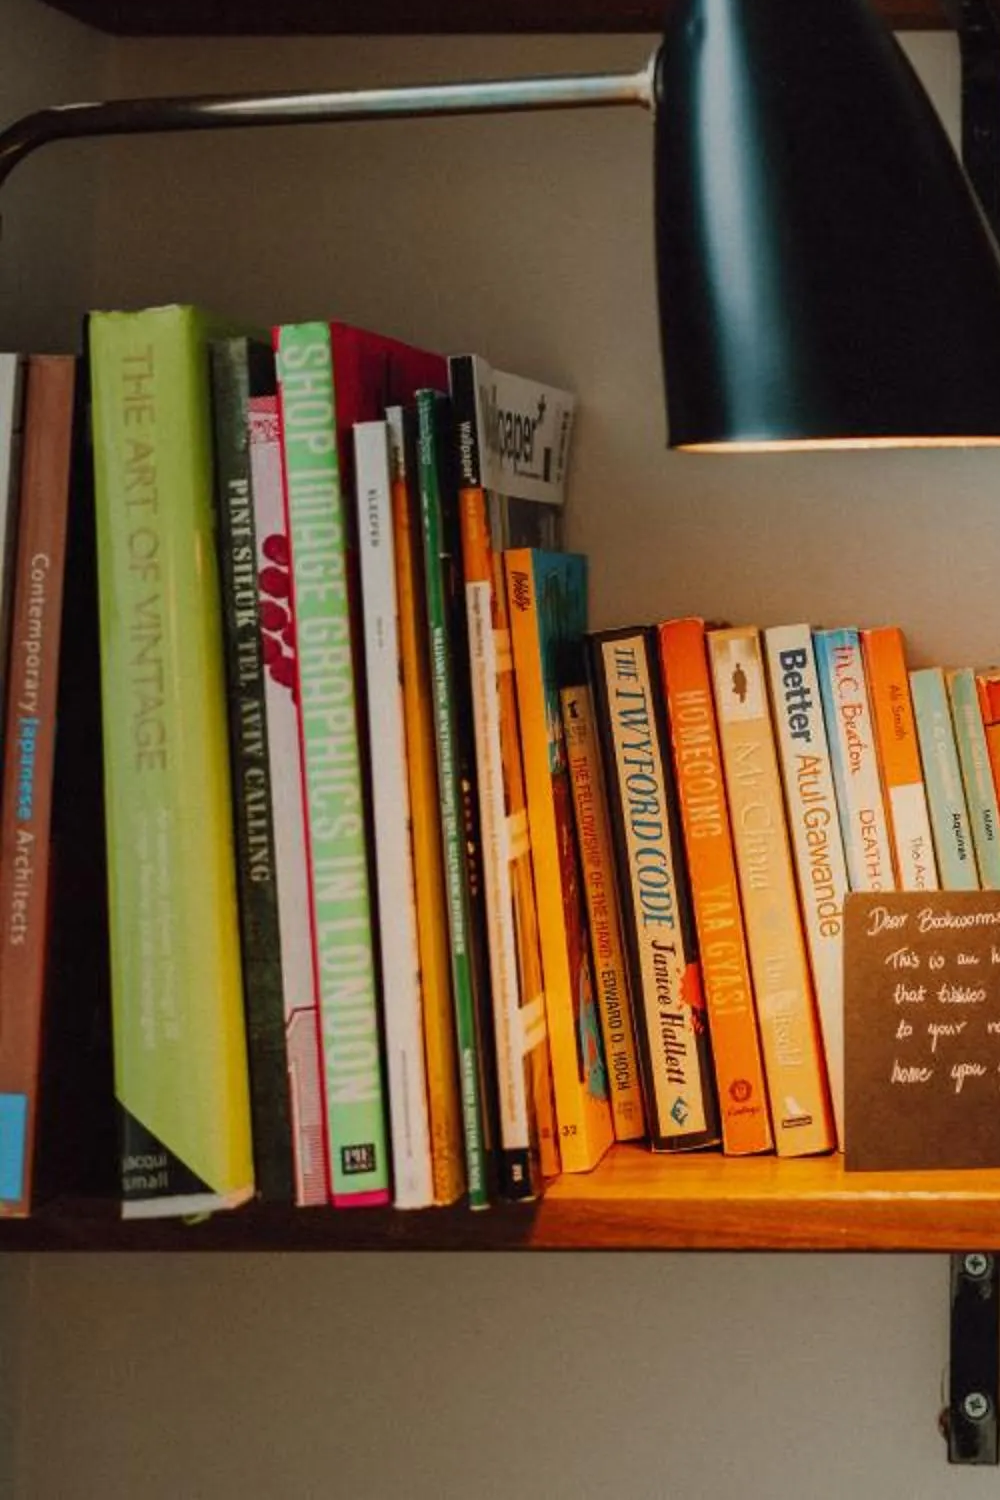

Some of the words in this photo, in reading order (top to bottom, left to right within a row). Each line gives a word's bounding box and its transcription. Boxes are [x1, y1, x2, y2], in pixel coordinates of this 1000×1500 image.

[122, 344, 156, 427] THE
[282, 342, 335, 454] SHOP
[124, 438, 159, 515] ART
[226, 478, 251, 536] PINI
[128, 526, 161, 580] OF
[289, 468, 345, 601] IMAGE
[231, 545, 257, 627] SILUK
[16, 552, 50, 712] Contemporary
[236, 637, 258, 687] TEL
[613, 647, 639, 682] THE
[130, 593, 168, 773] VINTAGE
[779, 647, 815, 744] Better
[240, 695, 264, 756] AVIV
[297, 615, 362, 840] GRAPHICS
[616, 688, 663, 841] TWYFORD
[16, 717, 41, 820] Japanese
[795, 754, 826, 804] Atul
[841, 704, 869, 775] Beaton
[859, 809, 883, 879] DEATH
[244, 766, 271, 881] CALLING
[910, 836, 926, 859] The
[8, 827, 36, 945] Architects
[314, 853, 365, 901] IN
[633, 846, 675, 929] CODE
[700, 883, 736, 933] YAA
[803, 807, 844, 938] Gawande
[867, 906, 908, 935] Dear
[885, 948, 920, 969] This
[928, 955, 945, 970] is
[317, 916, 379, 1101] LONDON
[589, 871, 606, 891] OF
[601, 969, 623, 1030] EDWARD
[612, 1052, 632, 1091] HOCH
[651, 939, 679, 1005] Janice
[707, 940, 748, 1016] GYASI
[894, 983, 927, 1005] that
[659, 1011, 688, 1085] Hallett
[896, 1018, 913, 1041] to
[927, 1020, 967, 1053] your
